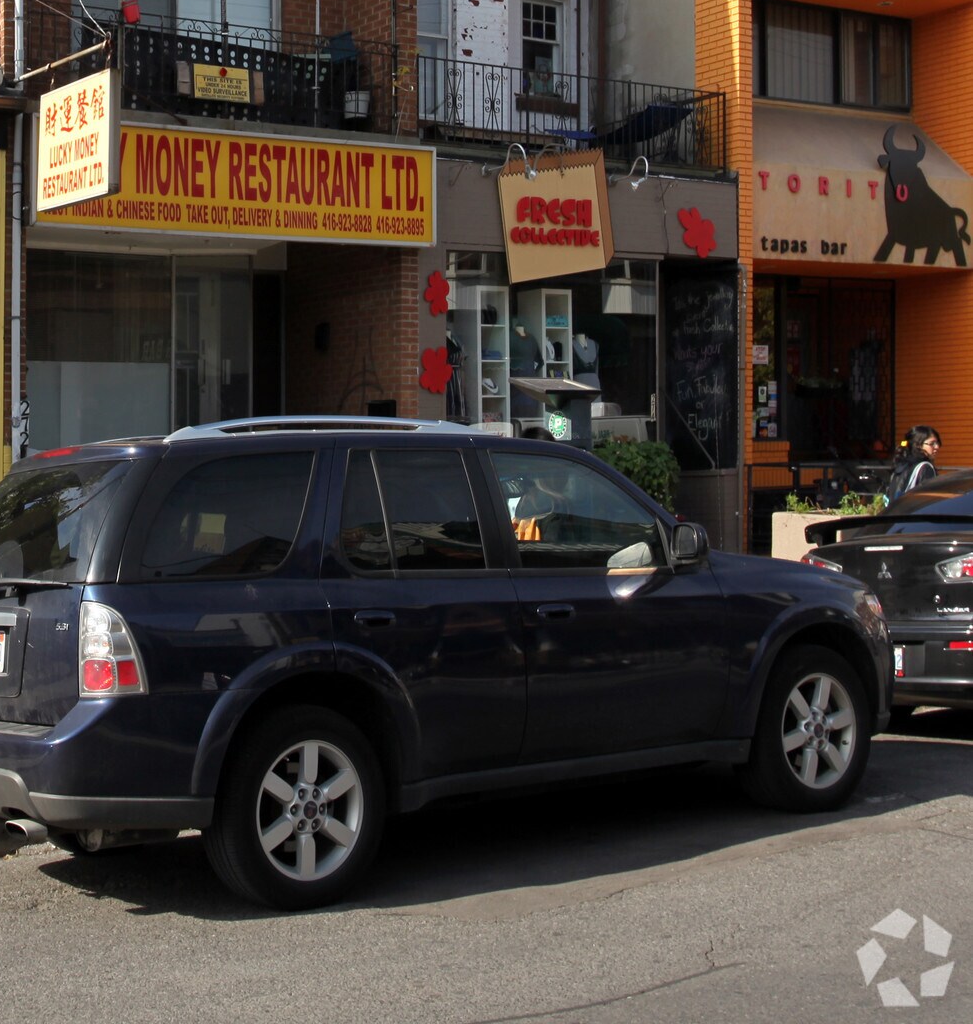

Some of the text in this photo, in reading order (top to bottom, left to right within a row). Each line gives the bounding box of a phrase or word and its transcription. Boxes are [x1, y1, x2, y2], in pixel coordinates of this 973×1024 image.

[213, 88, 247, 97] SURVEILLANCE
[49, 132, 99, 169] LUCKY MONEY
[42, 166, 88, 200] RESTAURANT
[136, 133, 223, 199] MONEY
[229, 141, 374, 208] RESTAURANT
[381, 155, 425, 212] LTD.
[72, 199, 104, 218] INDIAN
[107, 200, 114, 218] &
[117, 200, 155, 221] CHINESE
[158, 203, 181, 222] FOOD
[186, 204, 209, 224] TAKE
[233, 207, 273, 228] DELIVERY
[276, 209, 281, 228] &
[284, 210, 318, 230] DINNING
[322, 212, 372, 233] 416-923-8828
[376, 216, 425, 236] 416-923-8895
[515, 196, 593, 228] FRESH
[510, 226, 600, 248] COLLECTIVE
[761, 236, 848, 255] tapas bar
[20, 400, 30, 447] 272
